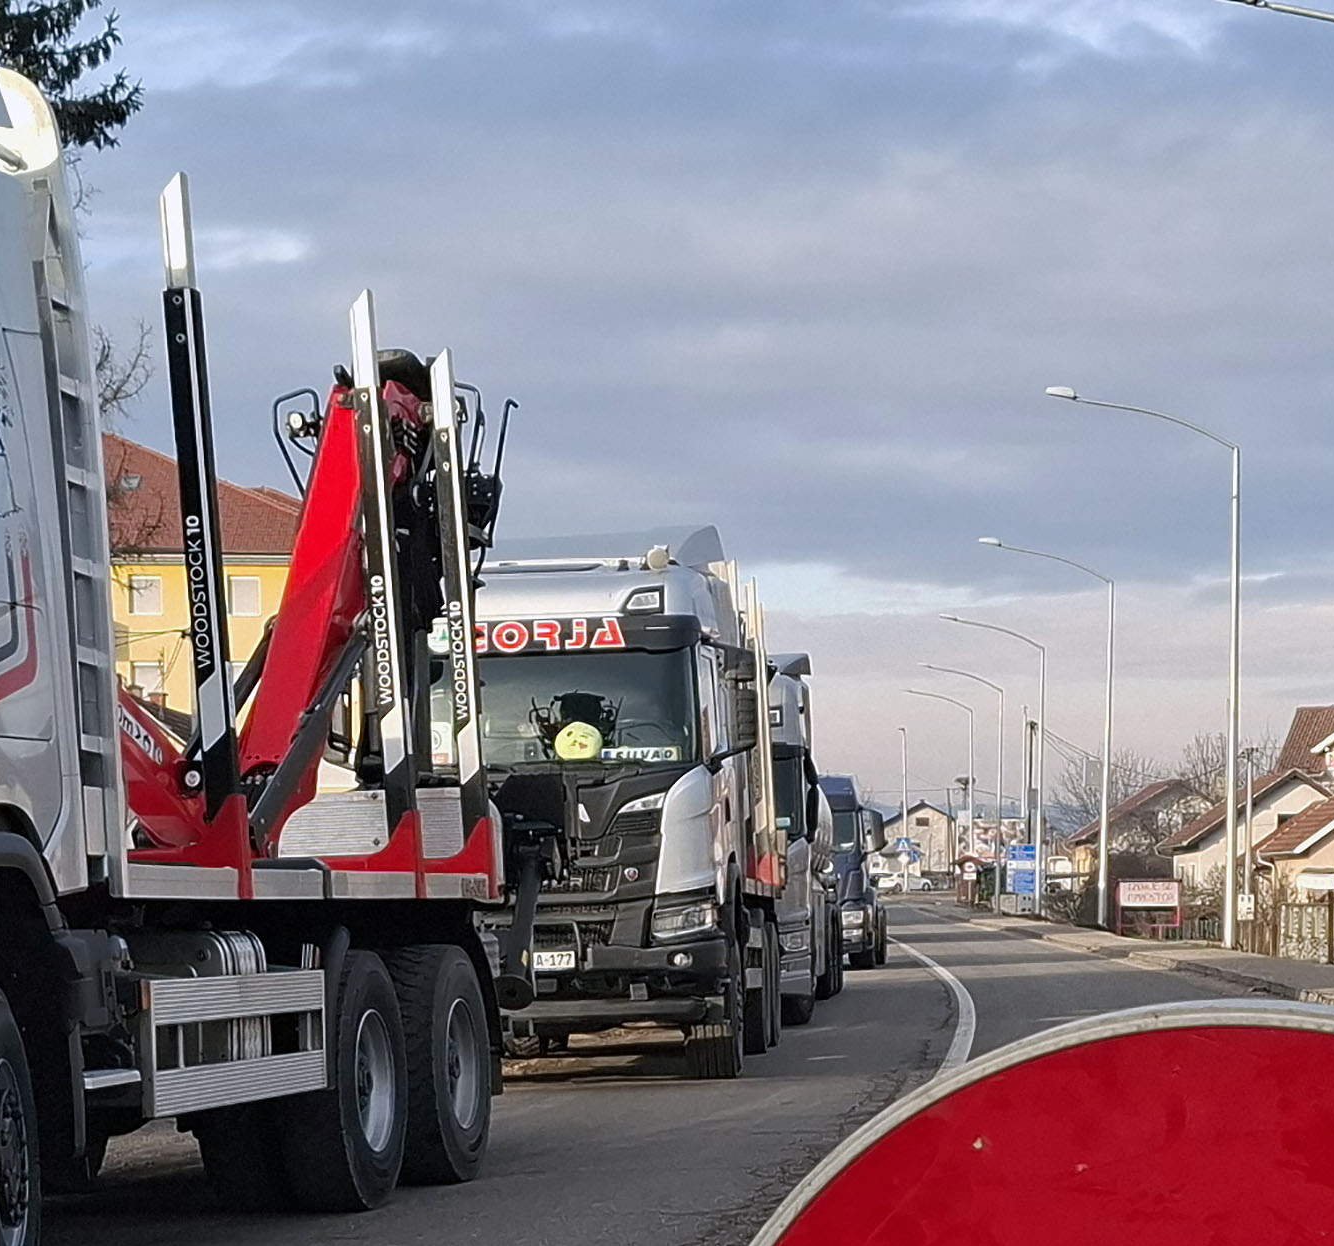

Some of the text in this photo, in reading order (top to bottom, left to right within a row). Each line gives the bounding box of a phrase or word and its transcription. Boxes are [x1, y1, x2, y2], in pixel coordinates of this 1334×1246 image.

[185, 514, 211, 669] WOODSTOCK 10
[370, 574, 393, 705] WOODSTOCK 10
[449, 600, 468, 721] WOODSTOCK 10
